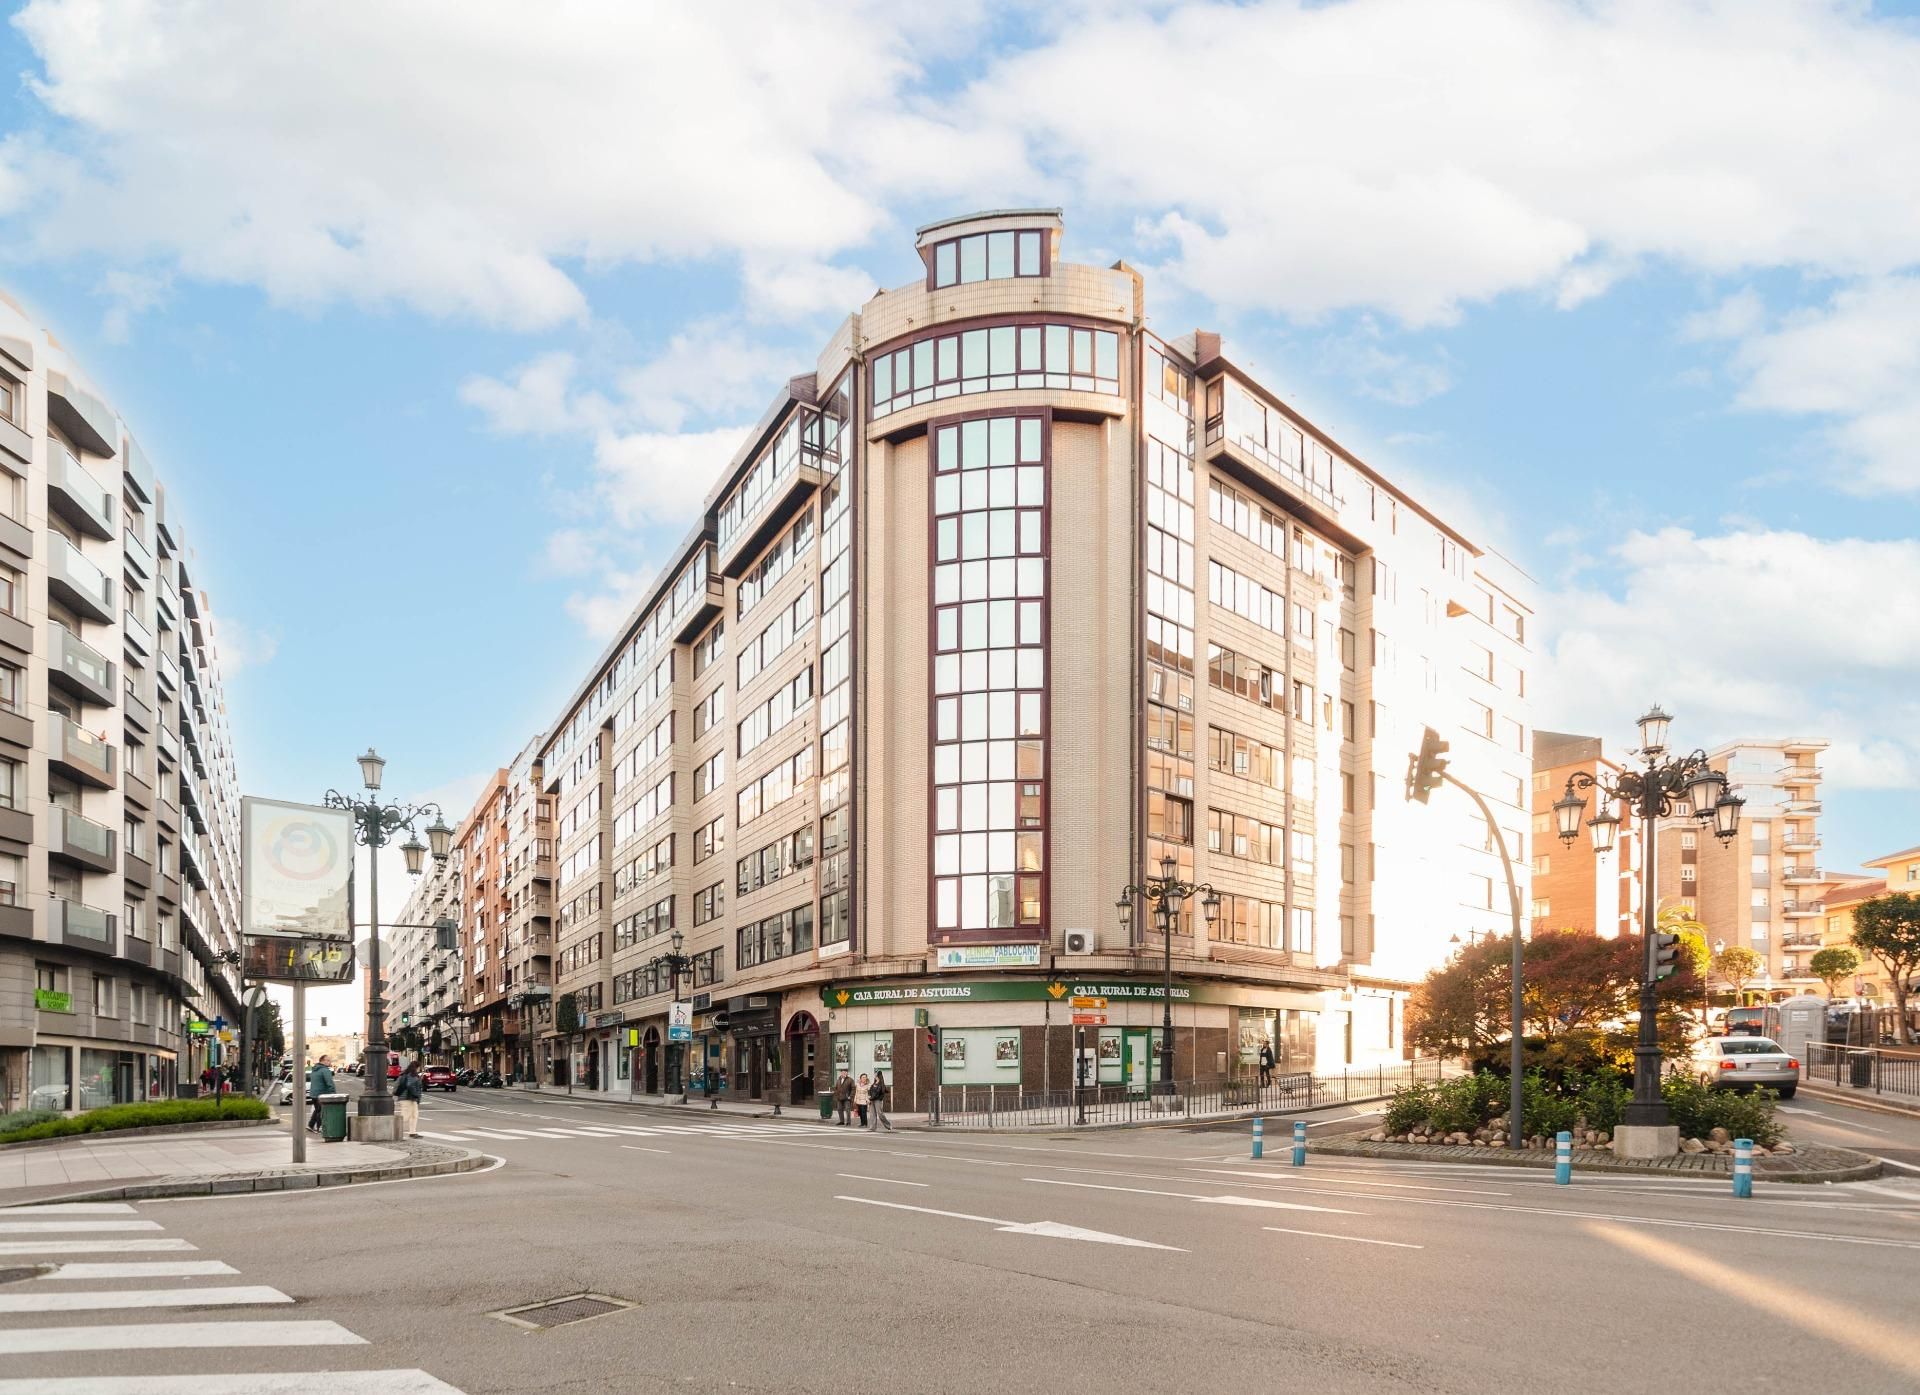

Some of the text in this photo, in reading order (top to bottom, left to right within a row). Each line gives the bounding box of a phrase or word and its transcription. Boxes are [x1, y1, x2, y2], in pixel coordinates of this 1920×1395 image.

[853, 987, 971, 1001] CAJA RURAL DE ASTURIAS
[1074, 986, 1190, 998] CAJA RURAL DE ASTRIAS
